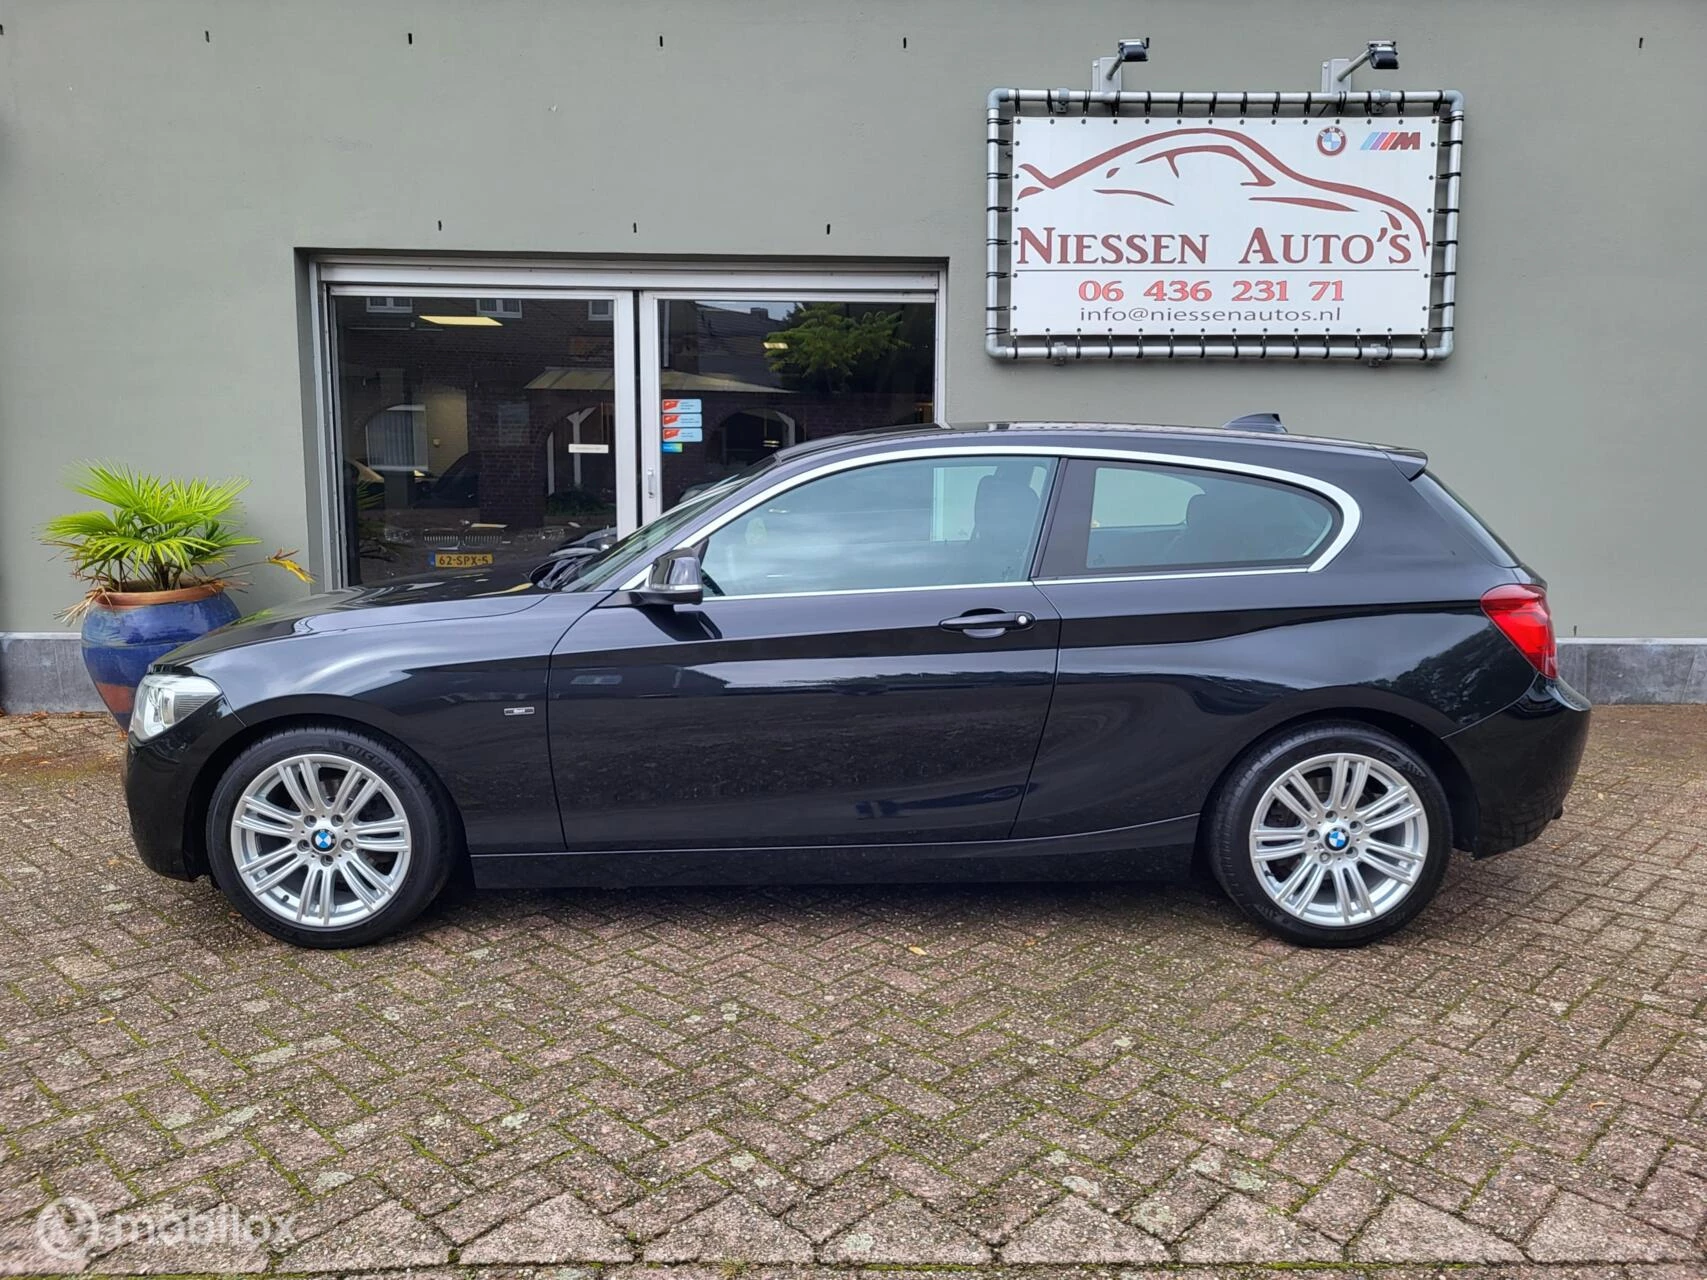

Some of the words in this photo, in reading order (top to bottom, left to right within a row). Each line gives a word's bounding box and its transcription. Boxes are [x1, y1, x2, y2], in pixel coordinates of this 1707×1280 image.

[1016, 227, 1210, 264] NIESSEN
[1238, 227, 1412, 264] AUTO'S
[1078, 280, 1124, 302] 06
[1143, 280, 1212, 302] 436
[1231, 280, 1289, 302] 231
[1308, 280, 1345, 302] 71
[1080, 307, 1341, 321] info@niessenautos.nl
